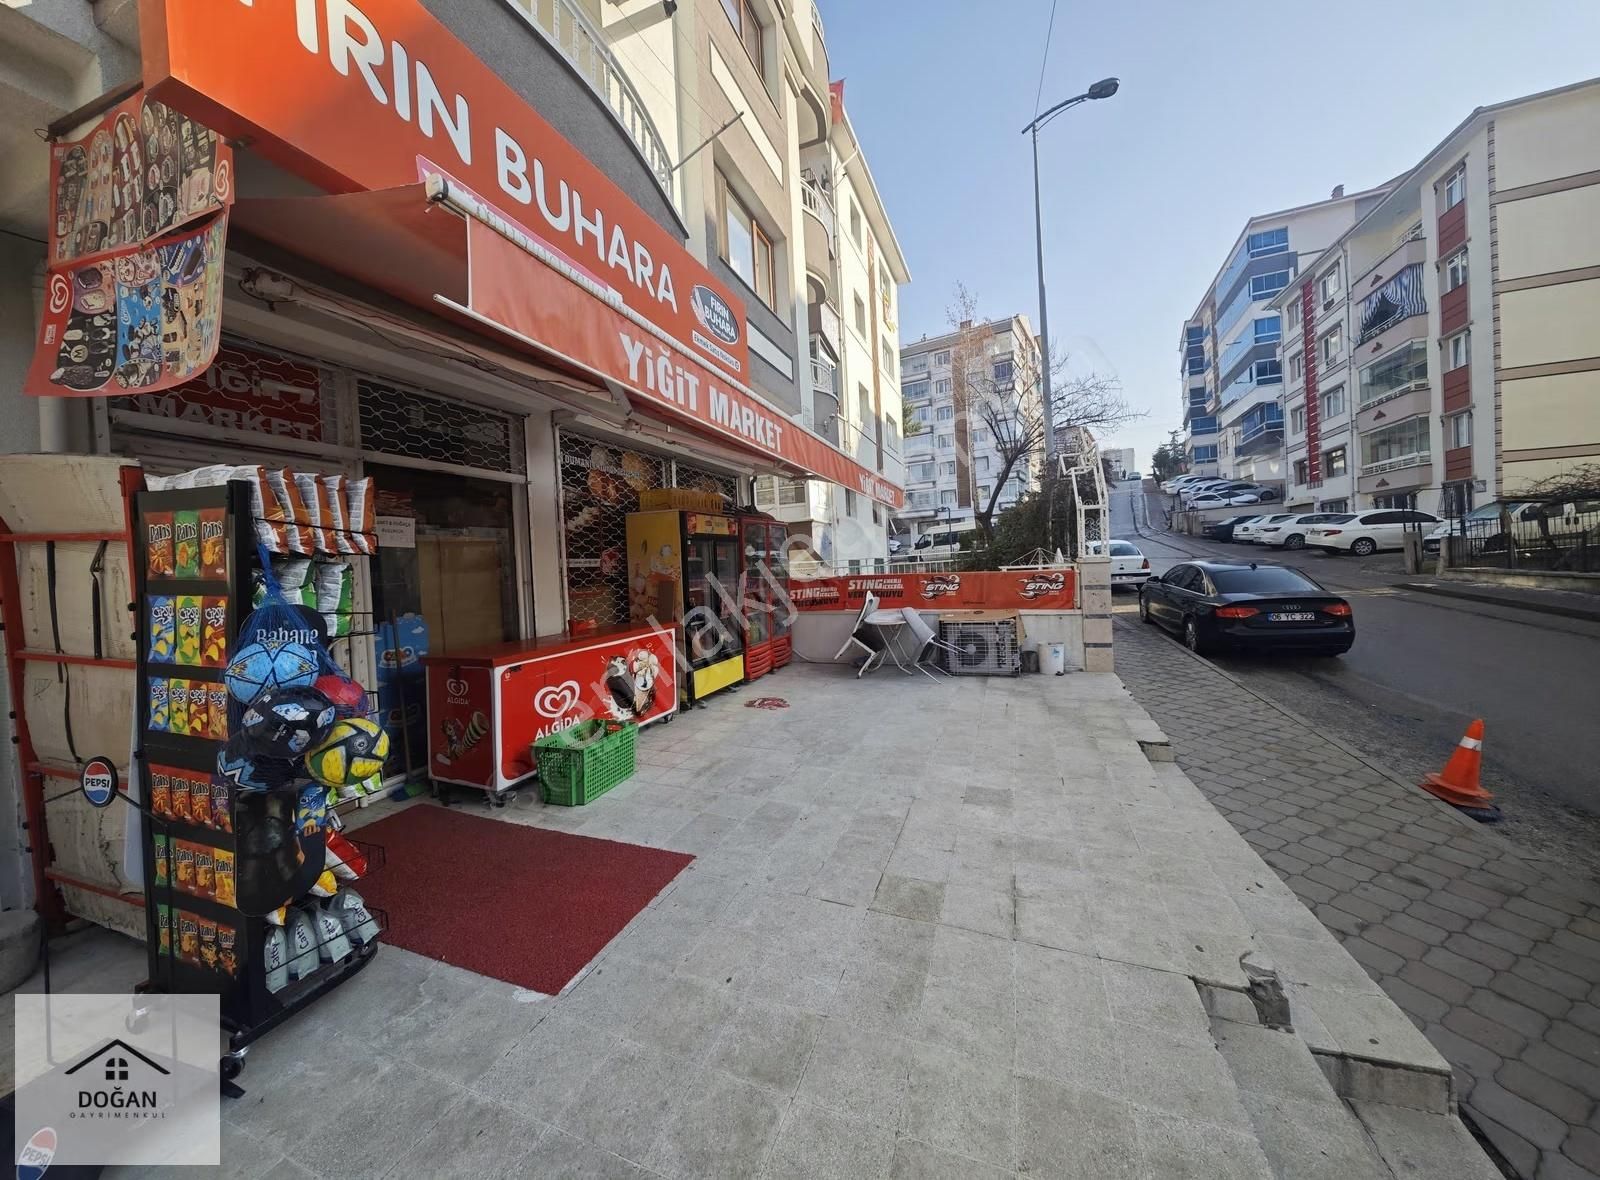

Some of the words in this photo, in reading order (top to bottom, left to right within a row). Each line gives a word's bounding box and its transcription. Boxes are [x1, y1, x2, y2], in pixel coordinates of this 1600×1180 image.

[495, 127, 678, 314] BUHARA
[711, 296, 730, 321] FIRIN
[704, 305, 736, 340] BUHARA
[619, 332, 700, 412] YİĞİT
[709, 385, 783, 453] MARKET
[138, 393, 315, 441] MARKET
[790, 587, 821, 600] STING
[848, 579, 884, 590] STING
[925, 583, 960, 591] STING
[1272, 613, 1281, 621] 06
[85, 778, 110, 788] PEPSI
[296, 921, 310, 949] Catty
